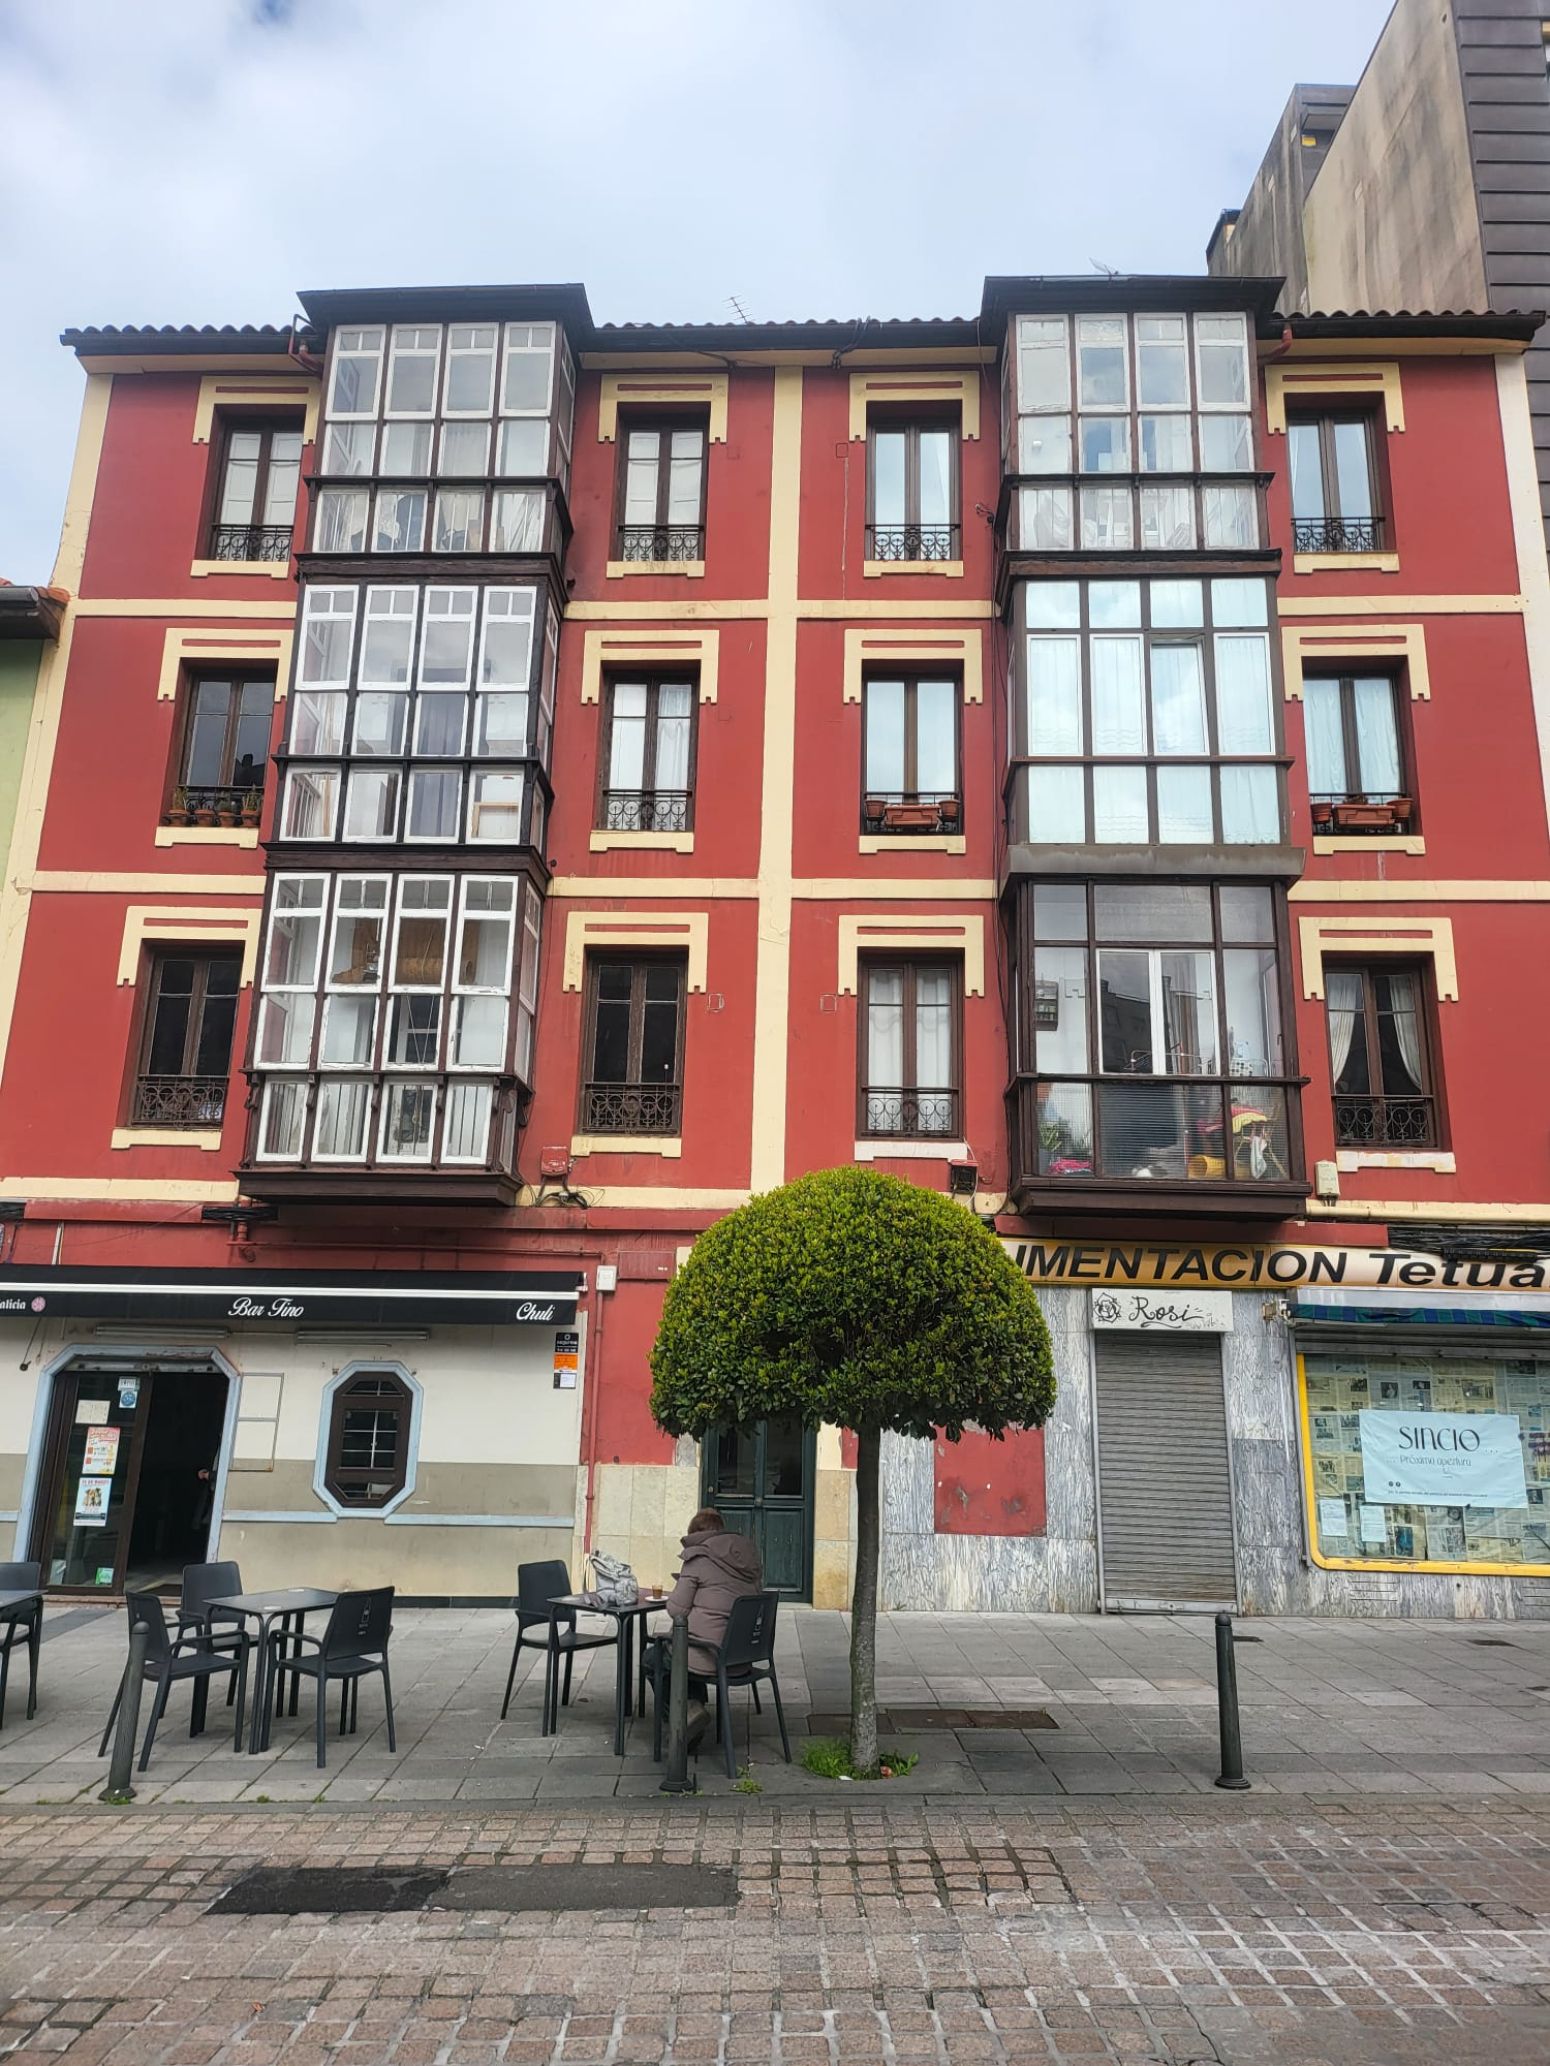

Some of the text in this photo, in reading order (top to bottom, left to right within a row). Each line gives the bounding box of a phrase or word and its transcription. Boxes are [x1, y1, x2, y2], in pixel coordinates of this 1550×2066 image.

[1369, 1253, 1550, 1288] Tetua
[0, 1299, 26, 1310] alicia
[227, 1296, 304, 1317] Bar Tino
[516, 1302, 555, 1321] Chuli
[1129, 1295, 1206, 1323] Rosi
